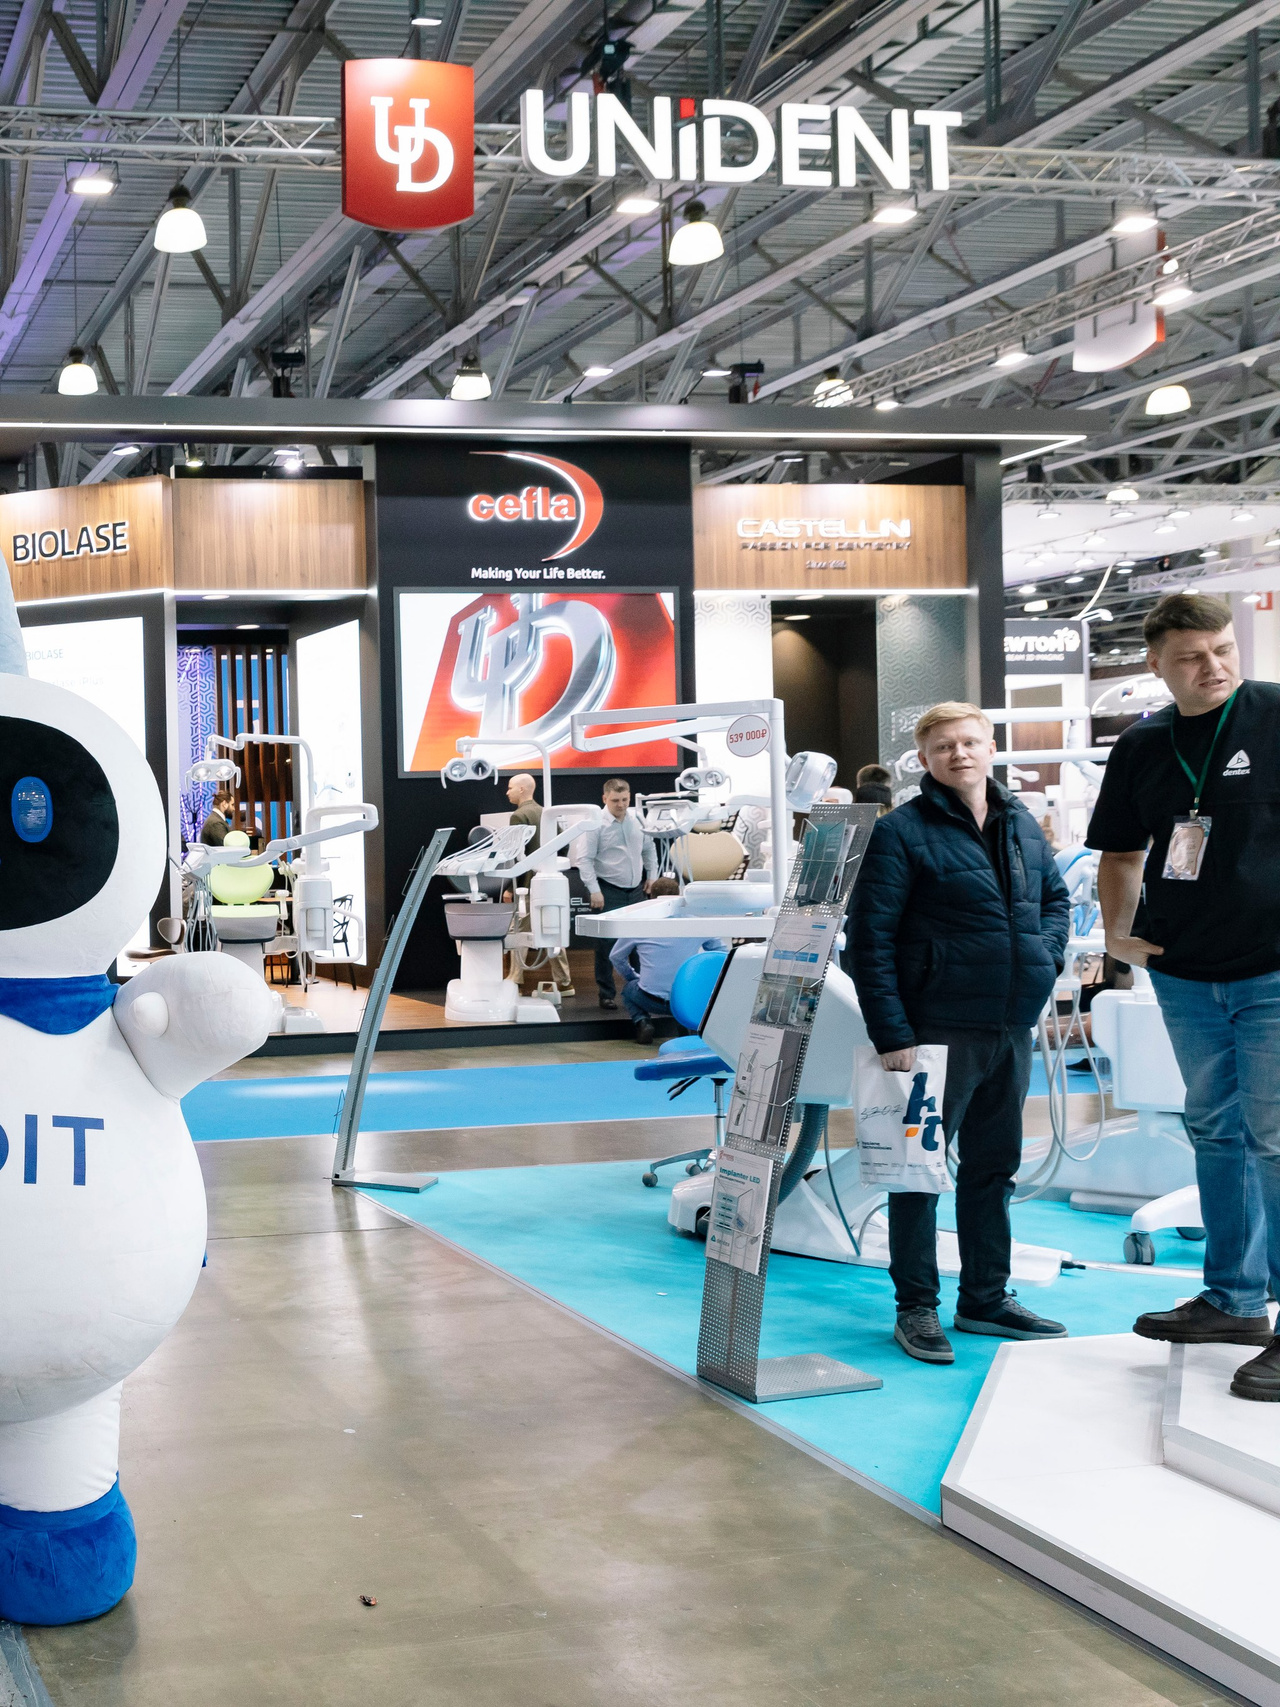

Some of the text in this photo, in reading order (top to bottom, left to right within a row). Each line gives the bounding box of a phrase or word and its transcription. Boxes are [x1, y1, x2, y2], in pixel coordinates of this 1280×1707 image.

[468, 486, 577, 521] cefla
[736, 518, 911, 538] CASTELLINI
[13, 522, 128, 563] BIOLASE
[471, 567, 606, 581] Making Your Life Better.
[729, 732, 744, 744] 539
[1222, 768, 1251, 777] dentex
[719, 1167, 749, 1181] Implanter
[749, 1175, 761, 1184] LED
